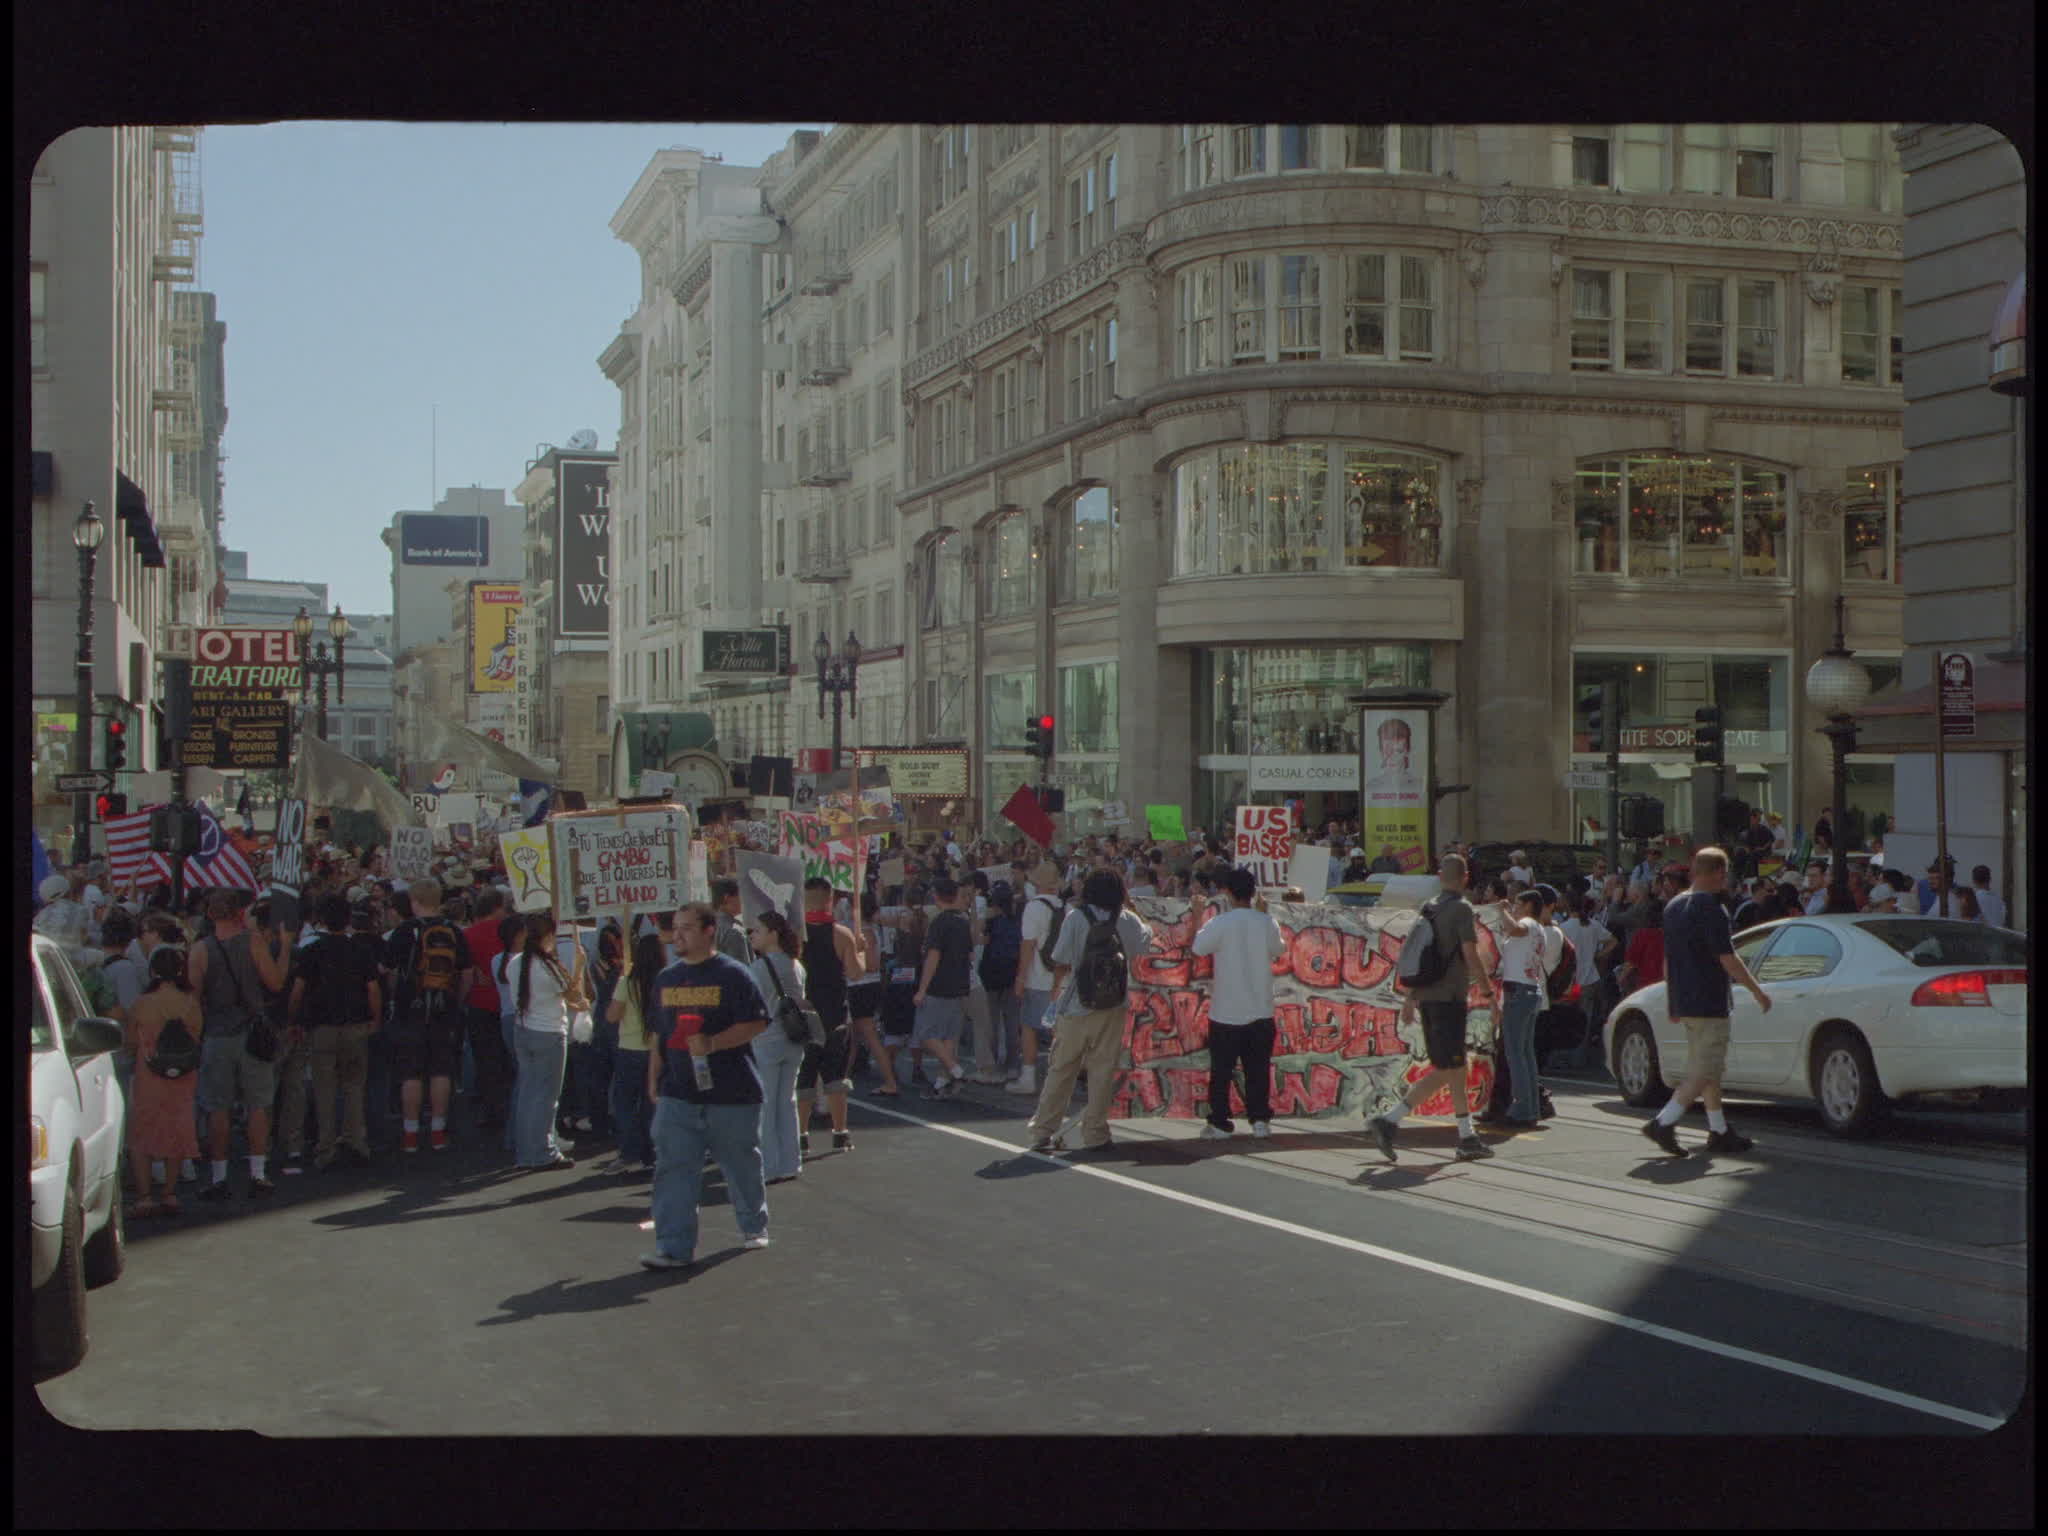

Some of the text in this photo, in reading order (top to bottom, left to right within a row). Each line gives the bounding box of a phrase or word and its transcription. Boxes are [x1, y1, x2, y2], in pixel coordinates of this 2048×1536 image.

[407, 548, 483, 558] Bank of America
[190, 665, 303, 687] TRATFORD
[517, 631, 528, 742] HERBERT
[219, 705, 286, 718] GALLERY
[1618, 730, 1650, 746] TITE
[1258, 768, 1355, 778] CASUAL CORNER
[278, 799, 304, 843] NO
[397, 828, 425, 845] NO
[786, 816, 820, 848] NO
[1237, 832, 1291, 860] BASES
[272, 843, 302, 884] WAR
[598, 848, 650, 867] CAMBIO
[614, 867, 655, 883] QUIERES
[594, 884, 657, 906] EL MUNDO
